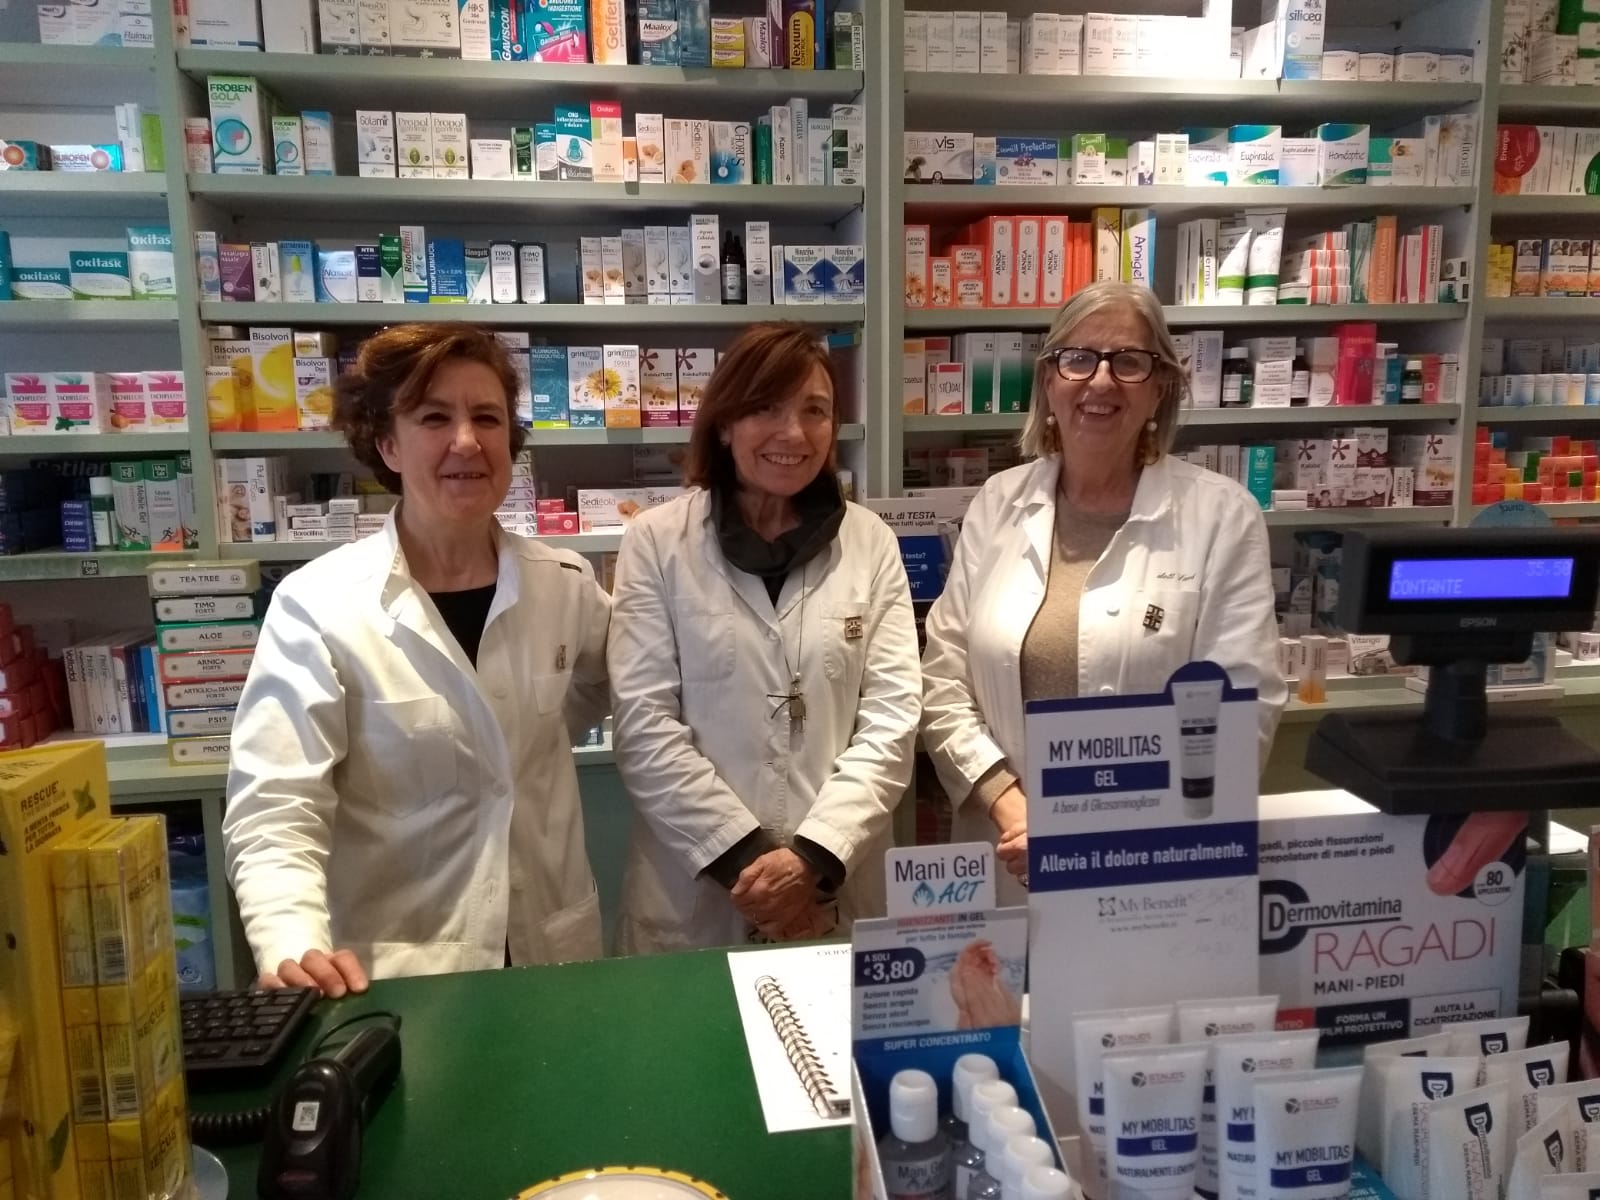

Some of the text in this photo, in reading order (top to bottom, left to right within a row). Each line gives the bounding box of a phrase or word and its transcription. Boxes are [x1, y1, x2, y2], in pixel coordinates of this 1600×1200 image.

[1288, 9, 1322, 22] silicea
[501, 7, 511, 61] GAVISCON
[643, 23, 672, 32] Maalox
[759, 20, 768, 56] Maalox
[791, 18, 801, 66] Nexium
[210, 84, 252, 92] FROBEN
[211, 92, 240, 101] GOLA
[398, 118, 428, 127] Propol
[433, 118, 463, 128] Propol
[1021, 142, 1056, 152] Protection
[1132, 236, 1146, 280] Arnigel
[252, 332, 289, 341] Bisolvon
[214, 345, 251, 354] Bisolvon
[939, 381, 962, 393] STODAL
[581, 497, 616, 506] Sedigola
[897, 511, 905, 520] di
[908, 511, 936, 520] TESTA
[901, 519, 915, 527] tutti
[1391, 579, 1463, 595] CONTANTE
[1459, 617, 1497, 628] EPSON
[1049, 734, 1162, 763] MY MOBILITAS
[1094, 770, 1119, 787] GEL
[20, 780, 59, 812] RESCUE
[1052, 802, 1059, 814] A
[1060, 801, 1080, 814] base
[1082, 800, 1088, 812] di
[1287, 837, 1323, 851] piccole
[1326, 832, 1384, 847] fissurazioni
[1040, 841, 1248, 873] Allevia il dolore naturalmente.
[1260, 844, 1394, 864] crepolature di mani e piedi
[895, 854, 986, 883] Mani Gel
[1486, 870, 1503, 886] 80
[938, 881, 986, 905] ACT
[1143, 896, 1188, 911] Benefit
[957, 913, 967, 922] IN
[969, 912, 986, 921] GEL
[1268, 896, 1402, 932] Dermovitamina
[1313, 917, 1496, 975] RAGADI
[864, 952, 890, 963] A SOLI
[864, 987, 919, 999] Azione rapida
[863, 999, 914, 1010] Senza acqua
[1434, 1002, 1475, 1014] AIUTA LA
[863, 1010, 909, 1021] Senza alcol
[1335, 1011, 1387, 1024] FORMA UN
[1414, 1010, 1496, 1027] CICATRIZZAZIONE
[862, 1022, 886, 1032] Senza
[1321, 1020, 1404, 1037] FILM PROTETTIVO
[884, 1032, 991, 1051] SUPER CONCENTRATO
[1232, 1106, 1248, 1121] MY
[1122, 1117, 1195, 1135] MY MOBILITAS
[1151, 1139, 1168, 1151] GEL
[1276, 1151, 1294, 1166] MY
[1296, 1144, 1351, 1163] MOBILITAS
[898, 1164, 928, 1179] Mani
[1306, 1169, 1323, 1182] GEL
